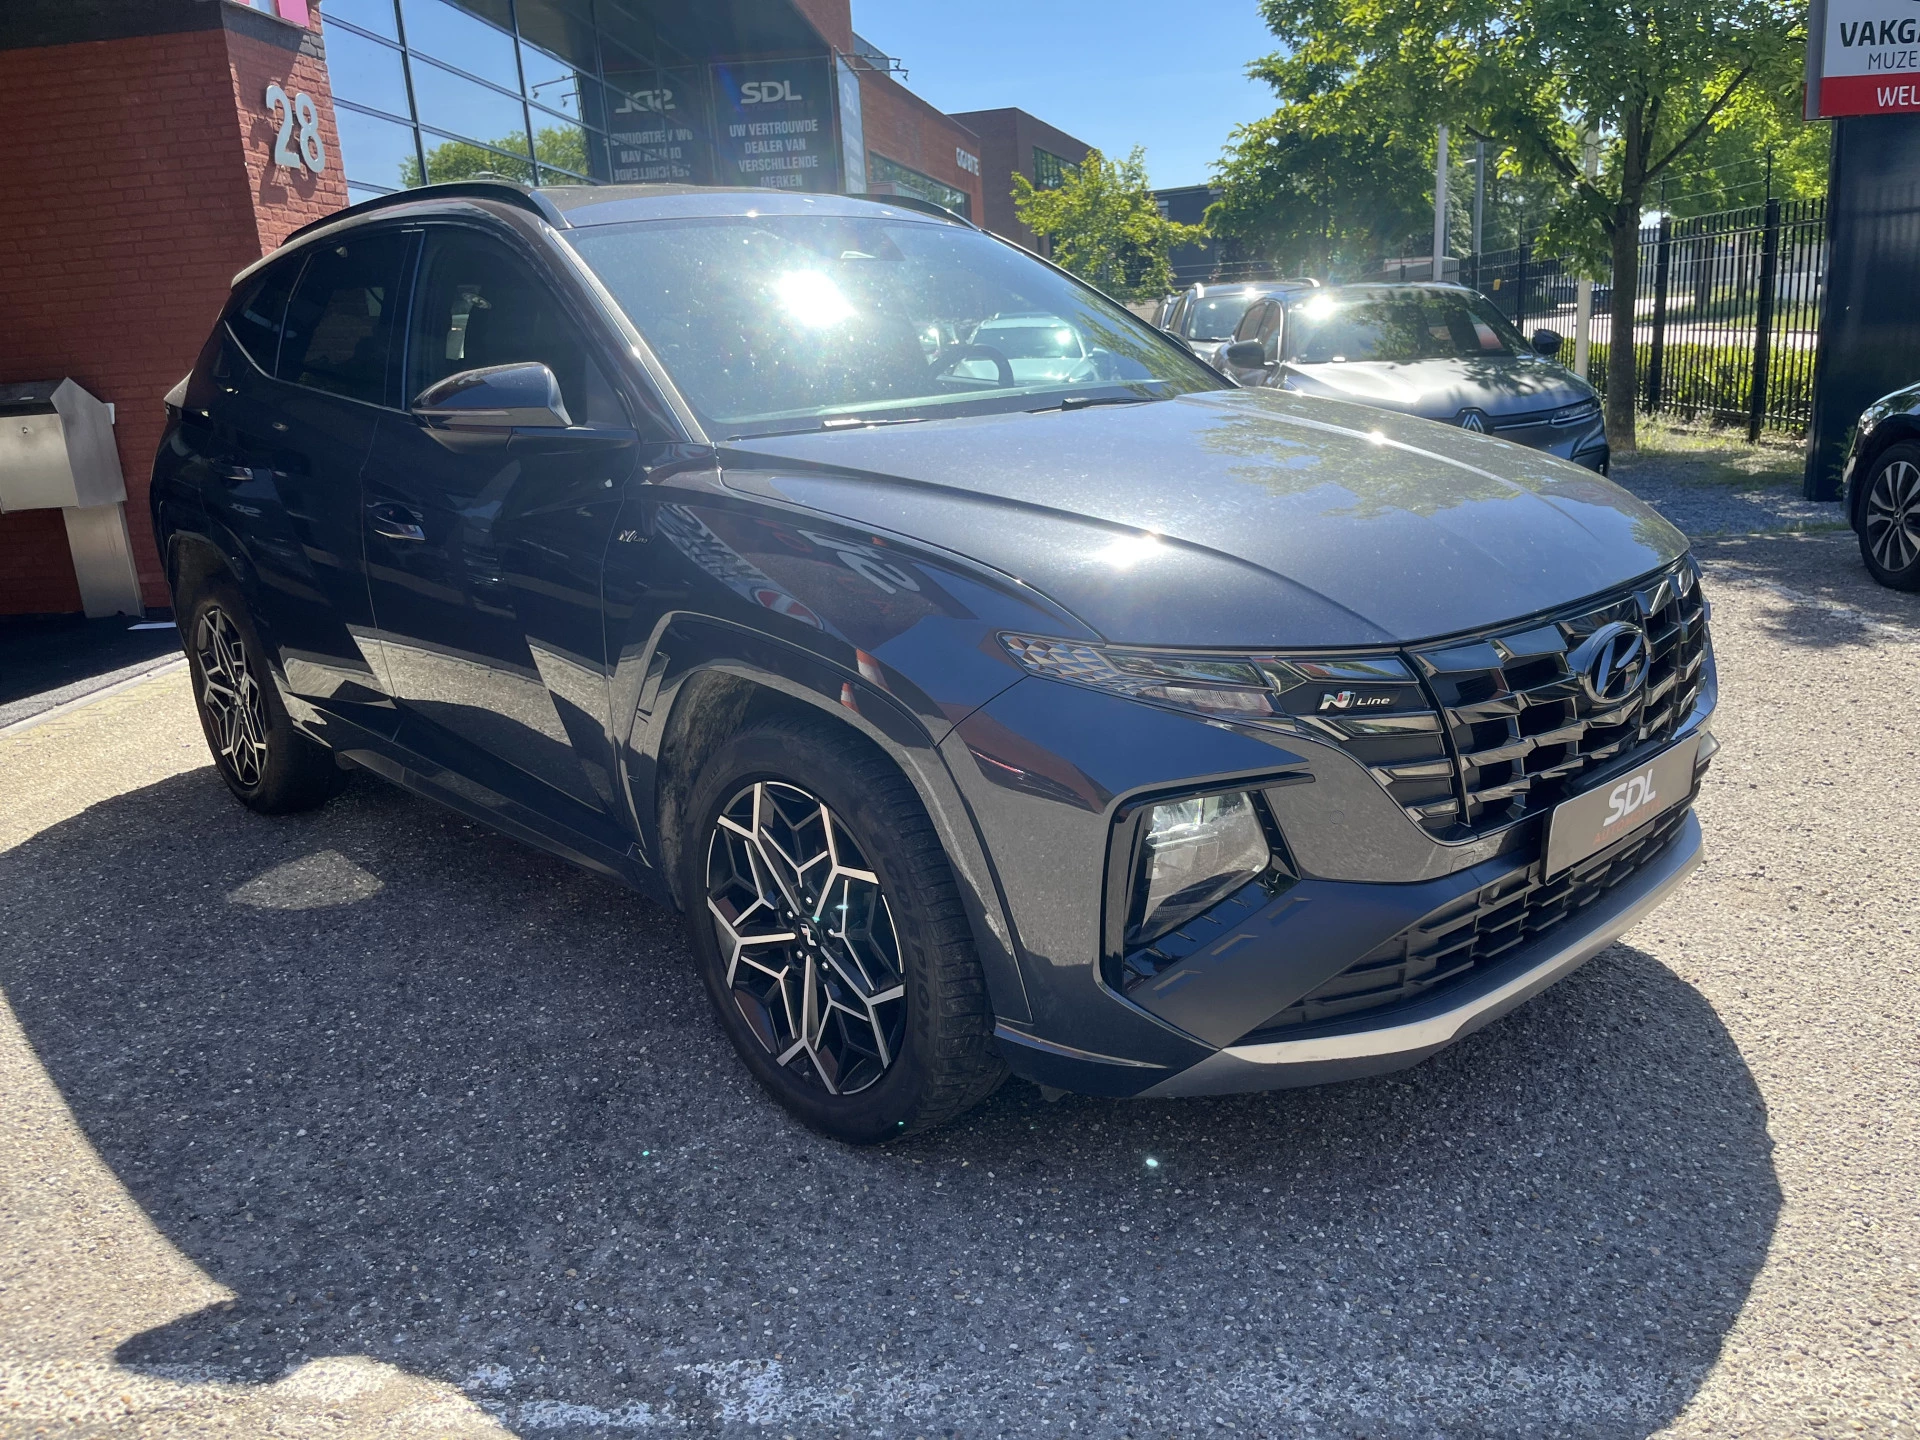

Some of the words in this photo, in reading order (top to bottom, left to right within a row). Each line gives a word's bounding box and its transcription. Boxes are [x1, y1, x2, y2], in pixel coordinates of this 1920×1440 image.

[1840, 18, 1920, 47] VAKG
[740, 80, 802, 104] SDL
[265, 84, 326, 173] 28
[729, 124, 746, 137] UW
[748, 119, 819, 136] VERTROUWDE
[744, 140, 783, 154] DEALER
[785, 138, 806, 152] VAN
[738, 155, 819, 172] VERSCHILLENDE
[760, 174, 803, 188] MERKEN
[1356, 697, 1390, 706] Line
[1603, 768, 1656, 827] SDL
